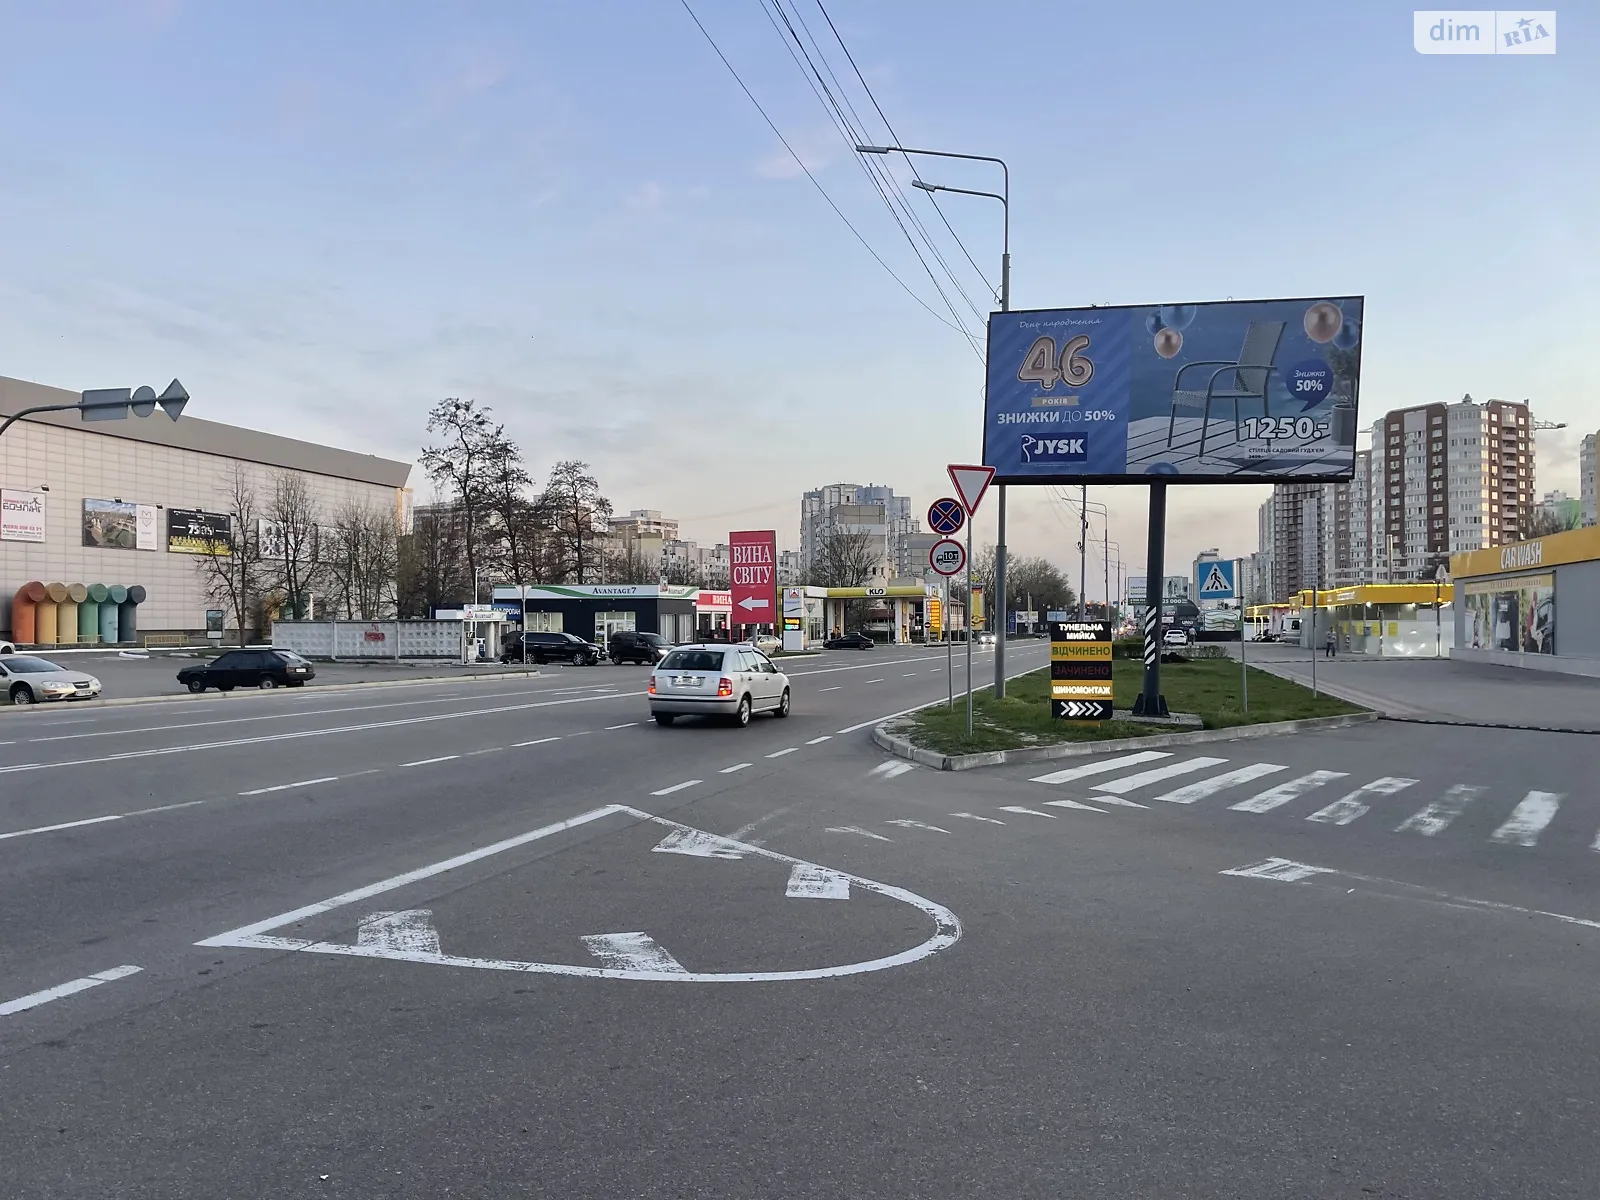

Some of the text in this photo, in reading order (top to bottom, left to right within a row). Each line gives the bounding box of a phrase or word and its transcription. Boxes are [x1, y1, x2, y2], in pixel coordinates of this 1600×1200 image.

[1042, 318, 1102, 328] народження
[1018, 335, 1094, 390] 46
[1294, 369, 1326, 378] Знижка
[1295, 379, 1323, 392] 50%
[997, 409, 1116, 425] ЗНИЖКИ ДО 50%
[1244, 416, 1329, 440] 1250.-
[1034, 438, 1085, 455] JYSK
[733, 545, 772, 564] ВИНА
[1500, 541, 1543, 569] CAR WASH
[733, 566, 772, 585] СВІТУ
[712, 594, 732, 605] ВИНА
[1058, 623, 1104, 631] ТУНЕЛЬНА
[1066, 632, 1097, 640] МИЙКА
[1052, 646, 1111, 656] ВІДЧИНЕНО
[1054, 666, 1109, 675] ЗАЧИНЕНО
[1053, 685, 1111, 694] ШИНОМОНТАЖ
